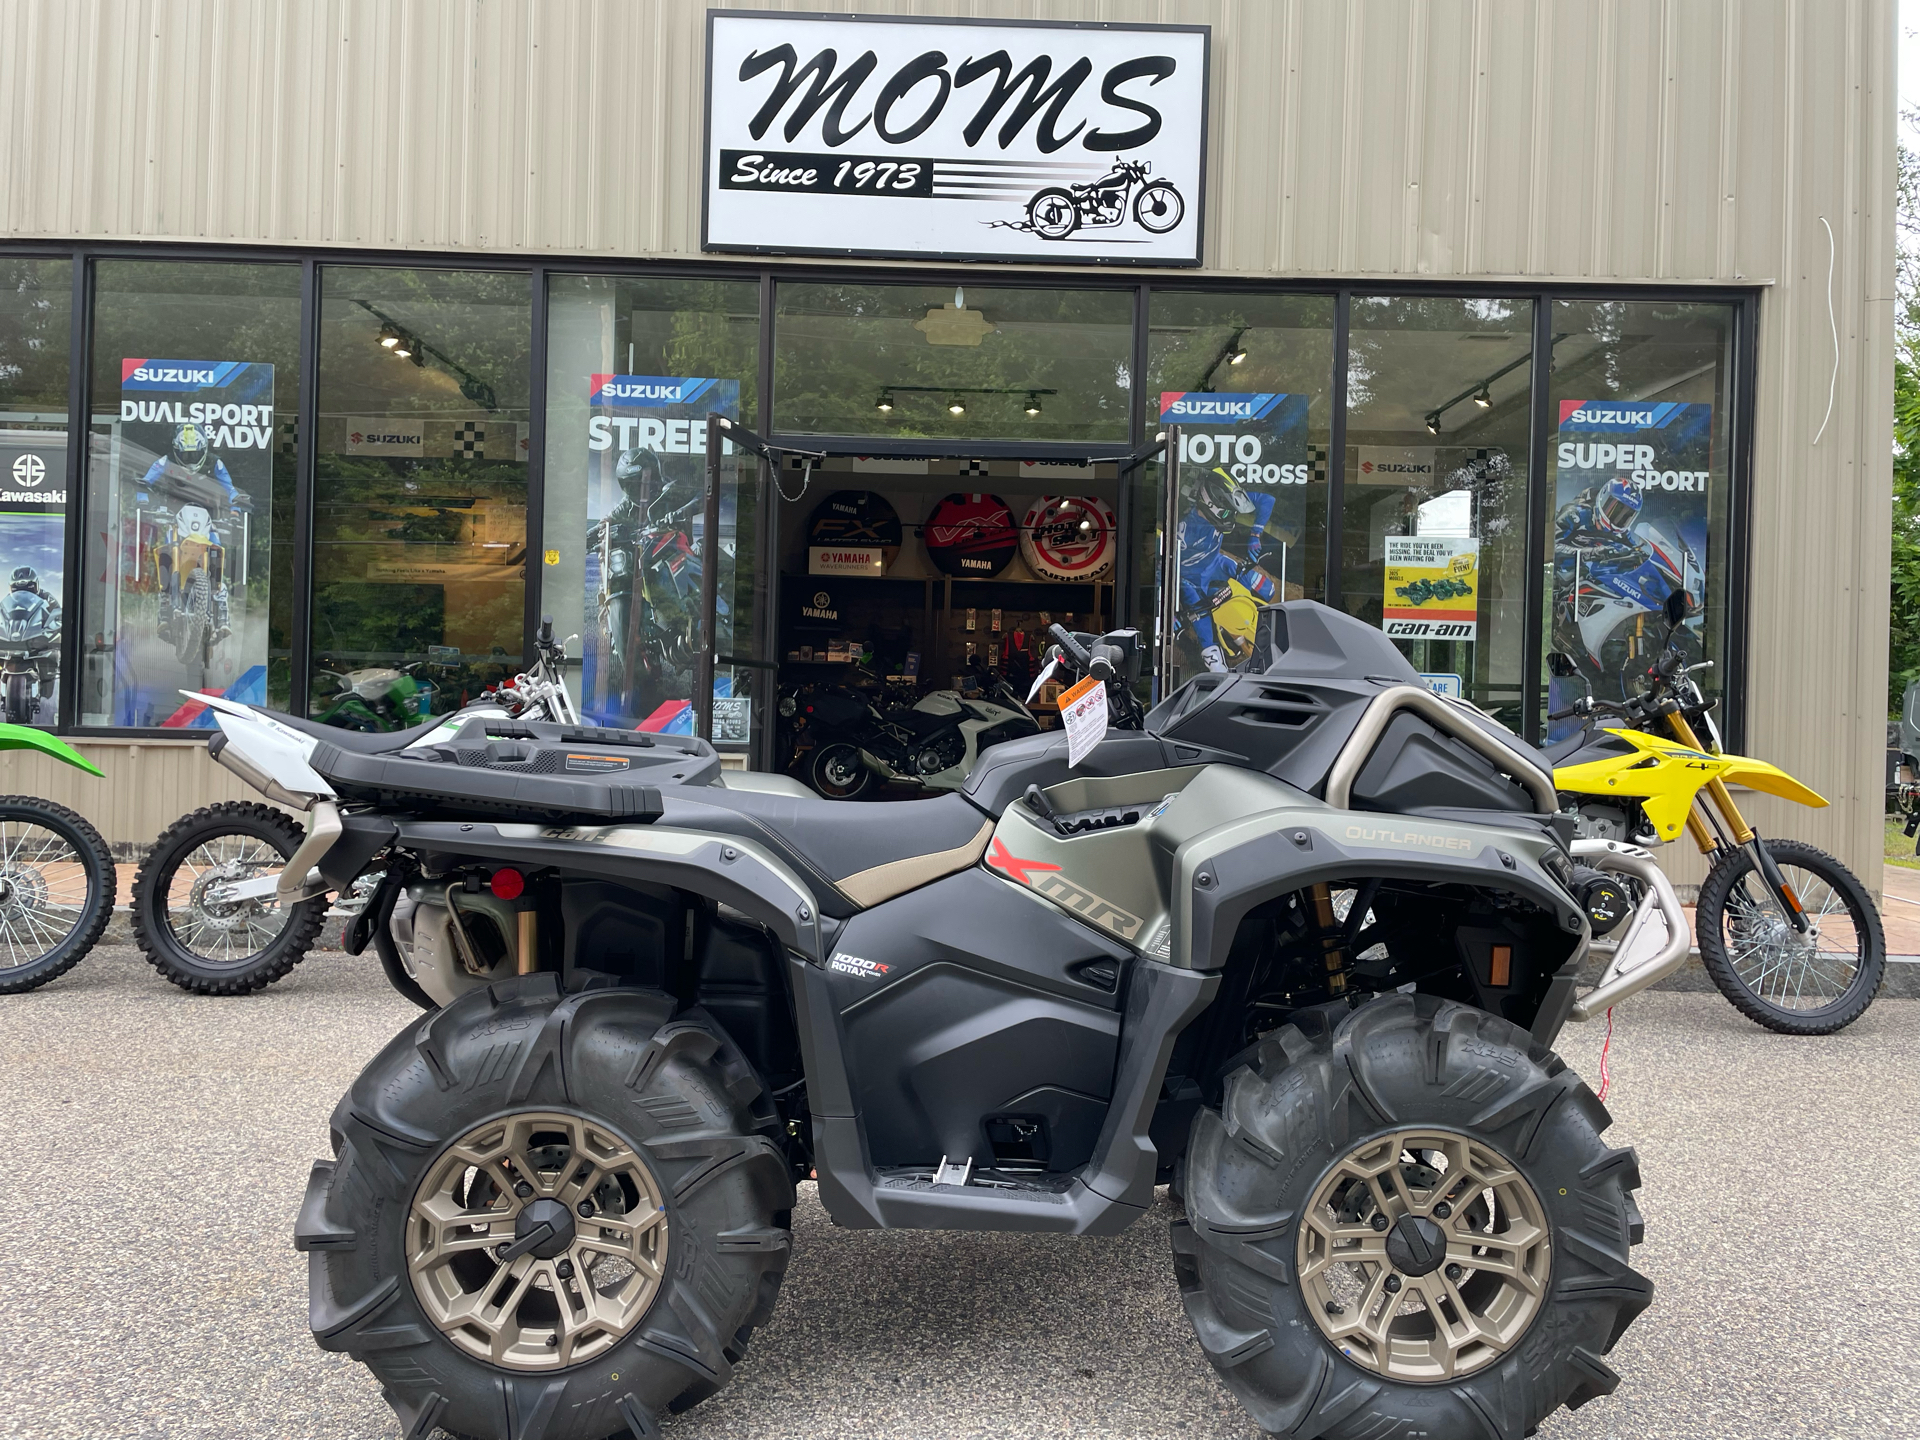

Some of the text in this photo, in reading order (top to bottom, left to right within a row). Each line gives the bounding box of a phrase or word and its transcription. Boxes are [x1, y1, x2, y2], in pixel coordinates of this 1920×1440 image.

[737, 42, 1177, 154] MOMS
[730, 155, 922, 190] Since 1973
[133, 367, 214, 384] SUZUKI
[602, 383, 682, 399] SUZUKI
[1171, 401, 1251, 415] SUZUKI
[1571, 410, 1652, 424] SUZUKI
[366, 434, 420, 444] SUZUKI
[1557, 442, 1655, 470] SUPER
[1230, 463, 1308, 485] CROSS
[1377, 464, 1431, 473] SUZUKI
[1631, 470, 1710, 492] SPORT
[832, 502, 857, 515] YAMAHA
[812, 519, 888, 538] FX
[932, 510, 1010, 543] VX
[832, 553, 870, 564] YAMAHA
[961, 558, 992, 570] YAMAHA
[1037, 562, 1109, 582] AIRHEAD
[1453, 564, 1470, 574] EVENT
[1612, 577, 1642, 600] SUZUKI
[802, 606, 838, 620] YAMAHA
[1387, 622, 1472, 637] can-am
[1432, 683, 1448, 693] ARE
[275, 726, 305, 744] Kawasaki
[540, 827, 653, 847] can-am
[1345, 826, 1471, 850] OUTLANDER
[831, 960, 867, 977] ROTAX
[834, 952, 889, 973] 1000R
